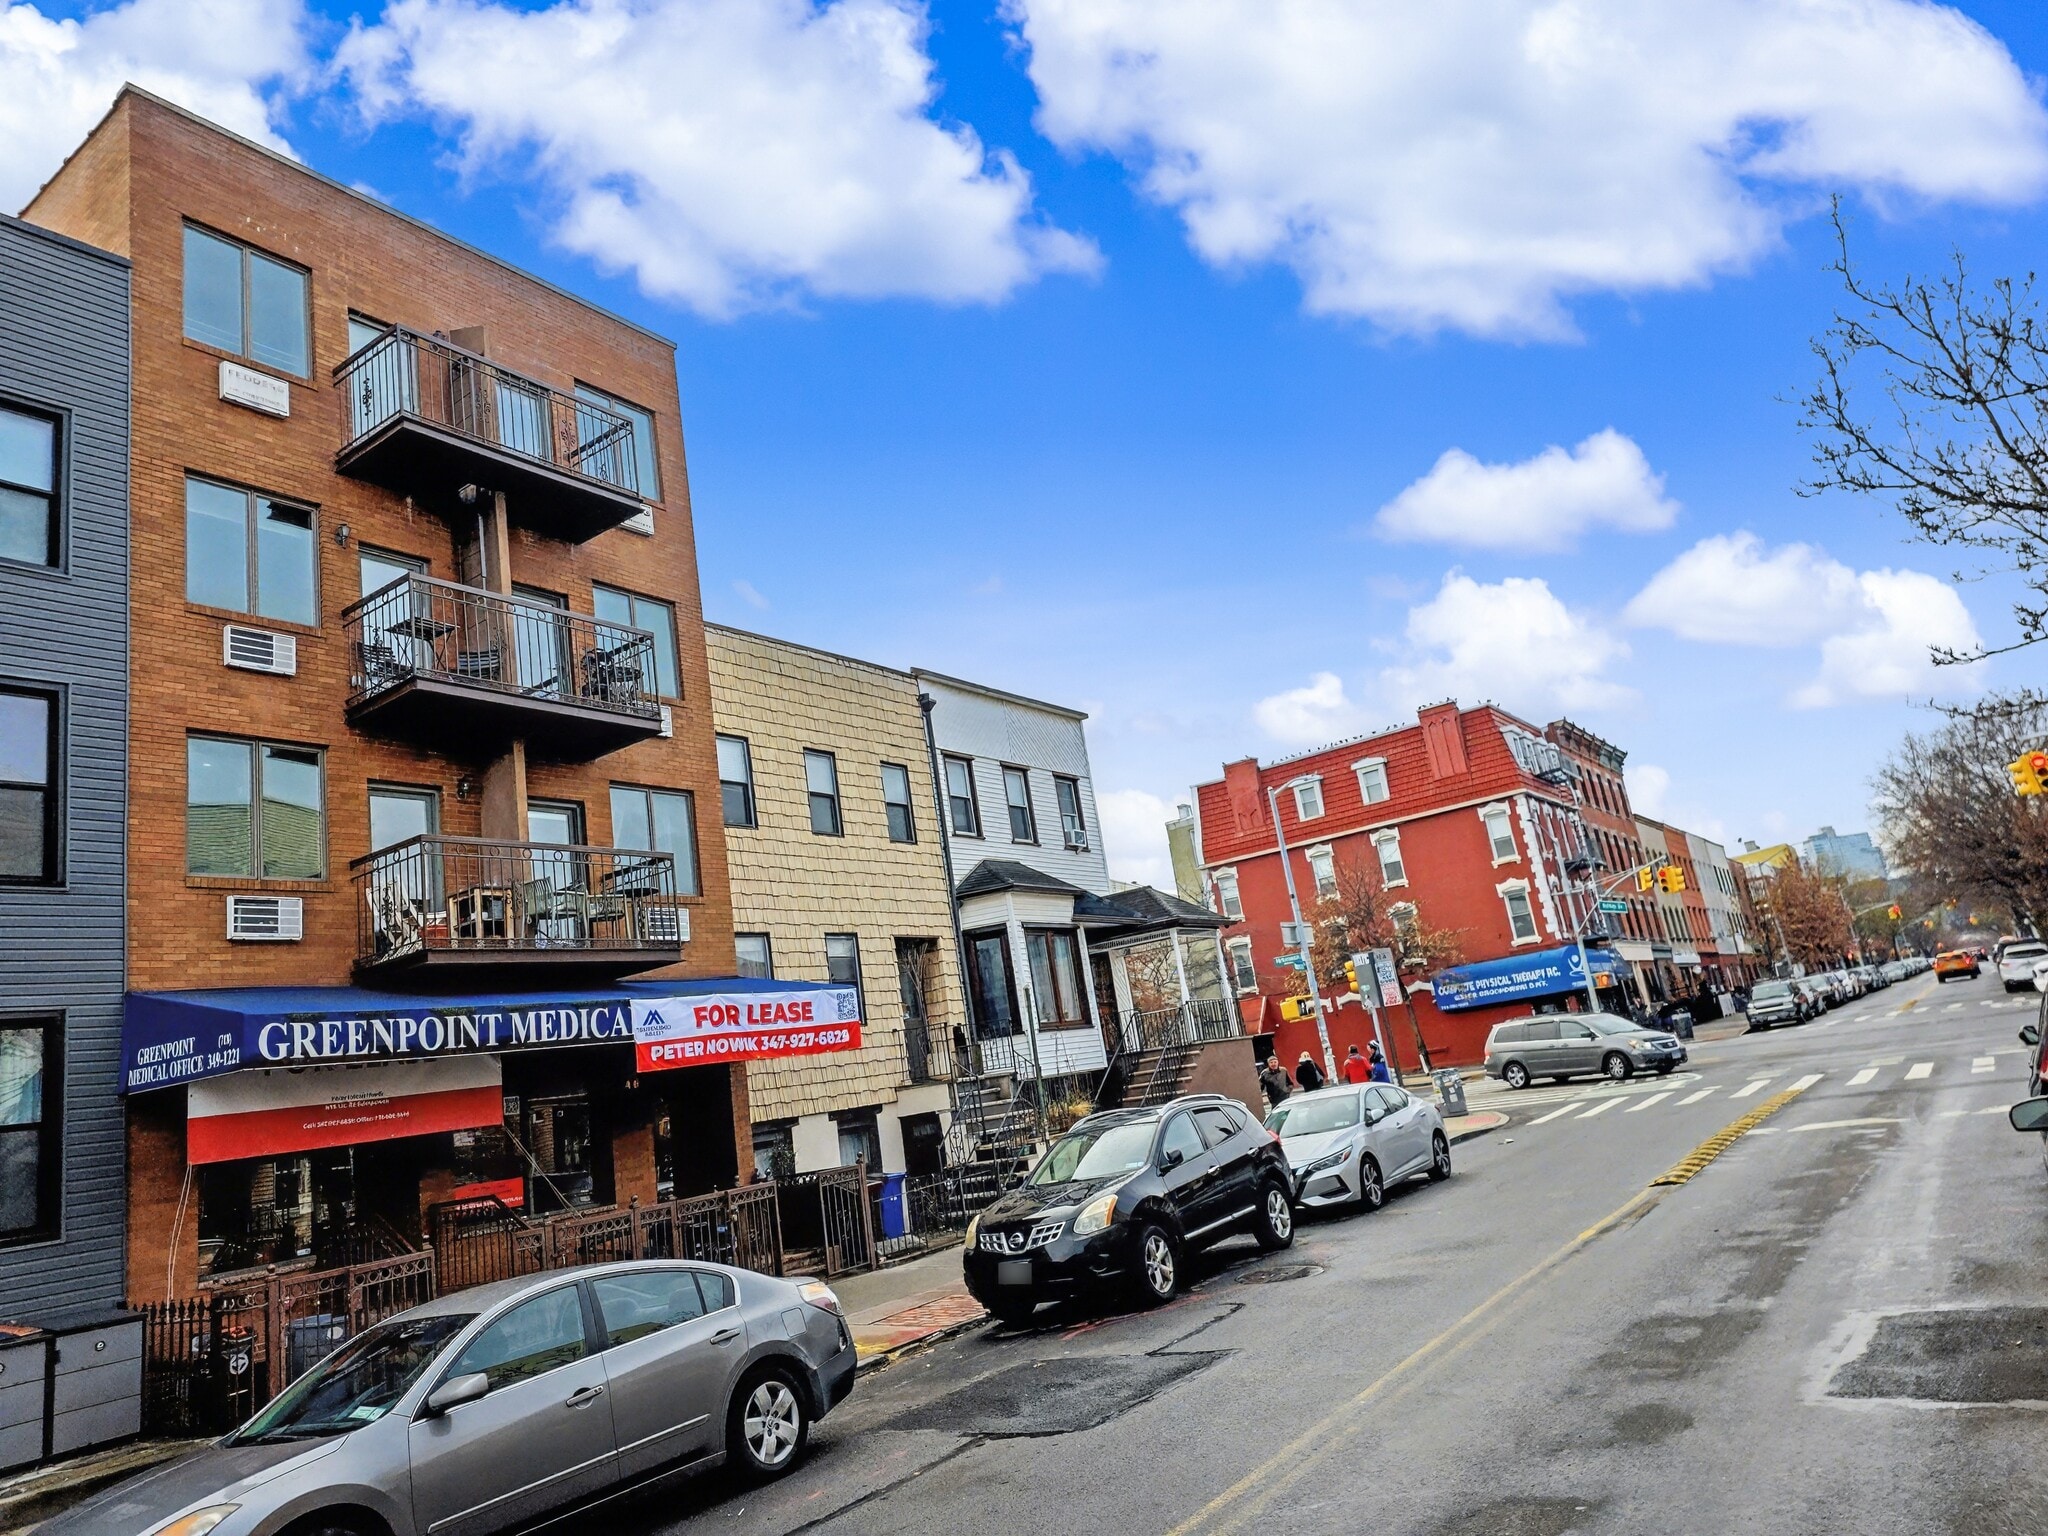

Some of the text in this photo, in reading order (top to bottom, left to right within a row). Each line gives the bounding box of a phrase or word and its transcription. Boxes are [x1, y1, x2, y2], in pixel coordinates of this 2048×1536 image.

[1475, 975, 1512, 990] PHYSICAL
[1511, 968, 1545, 983] THERAPY
[693, 1001, 814, 1029] FOR LEASE
[258, 1006, 634, 1061] GREENPOINT MEDICA
[137, 1037, 196, 1066] GREENPOINT
[207, 1047, 241, 1070] 349-1221
[651, 1041, 705, 1062] PETER
[706, 1036, 759, 1055] NOWIK
[127, 1054, 204, 1087] MEDICAL OFFICE
